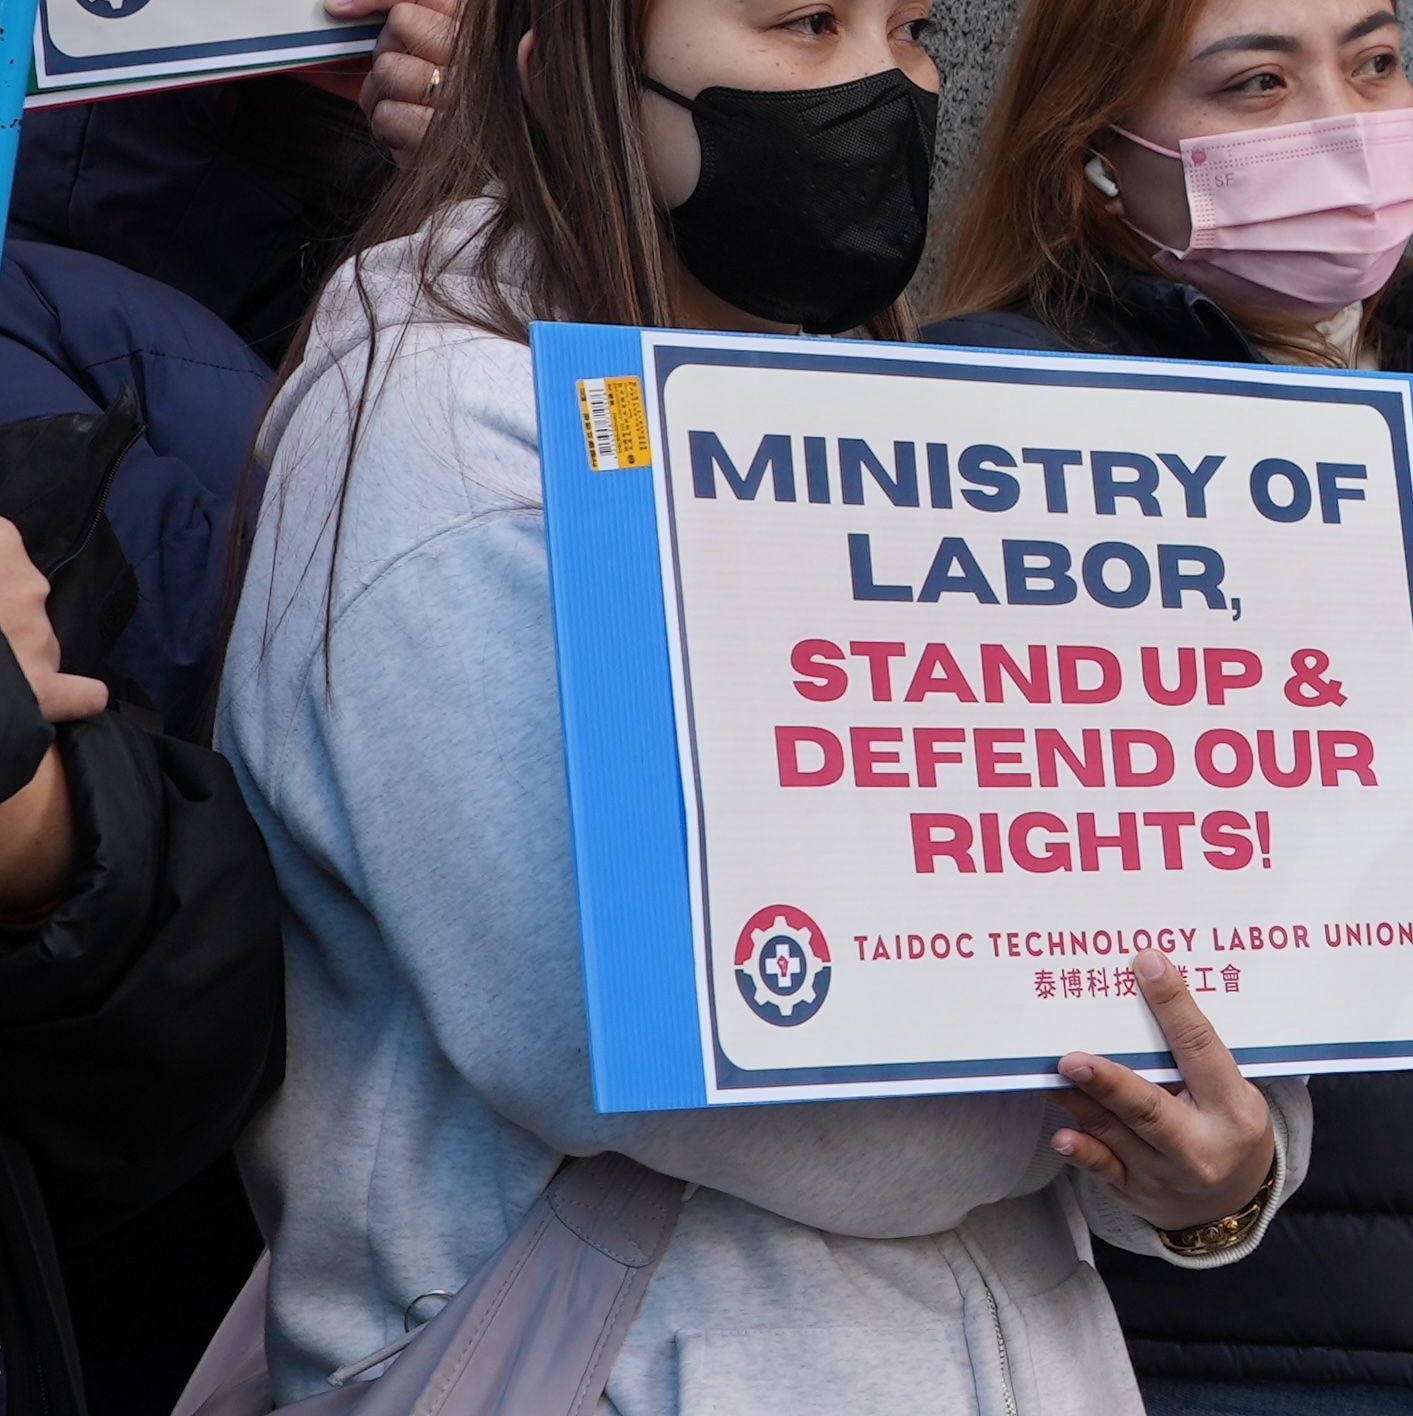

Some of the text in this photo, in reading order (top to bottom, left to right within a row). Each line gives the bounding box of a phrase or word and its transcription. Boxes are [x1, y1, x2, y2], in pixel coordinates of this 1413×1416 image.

[688, 430, 1367, 524] MINISTRY OF
[848, 533, 1241, 621] LABOR,
[791, 639, 1348, 707] STAND UP &
[775, 726, 1378, 788] DEFEND OUR
[910, 810, 1271, 873] RIGHTS!
[854, 922, 1413, 960] TAIDOC TECHNOLOGY LABOR UNION
[1035, 964, 1240, 999] 泰博科技工會
